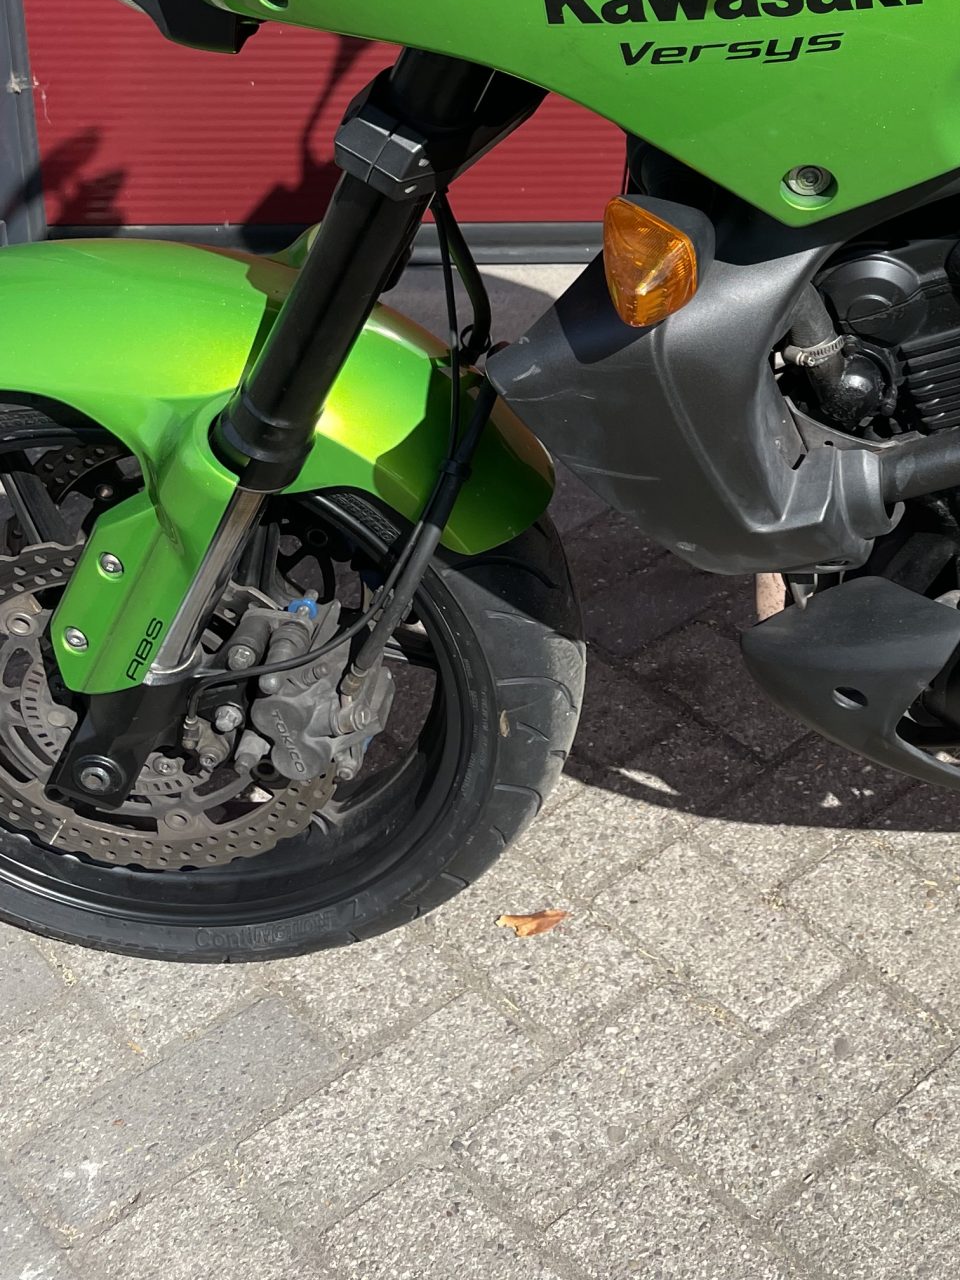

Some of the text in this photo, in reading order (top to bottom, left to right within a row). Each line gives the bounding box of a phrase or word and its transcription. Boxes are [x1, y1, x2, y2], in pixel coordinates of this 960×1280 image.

[619, 32, 844, 66] Versys
[126, 618, 163, 681] ABS
[272, 709, 305, 773] TOKICO
